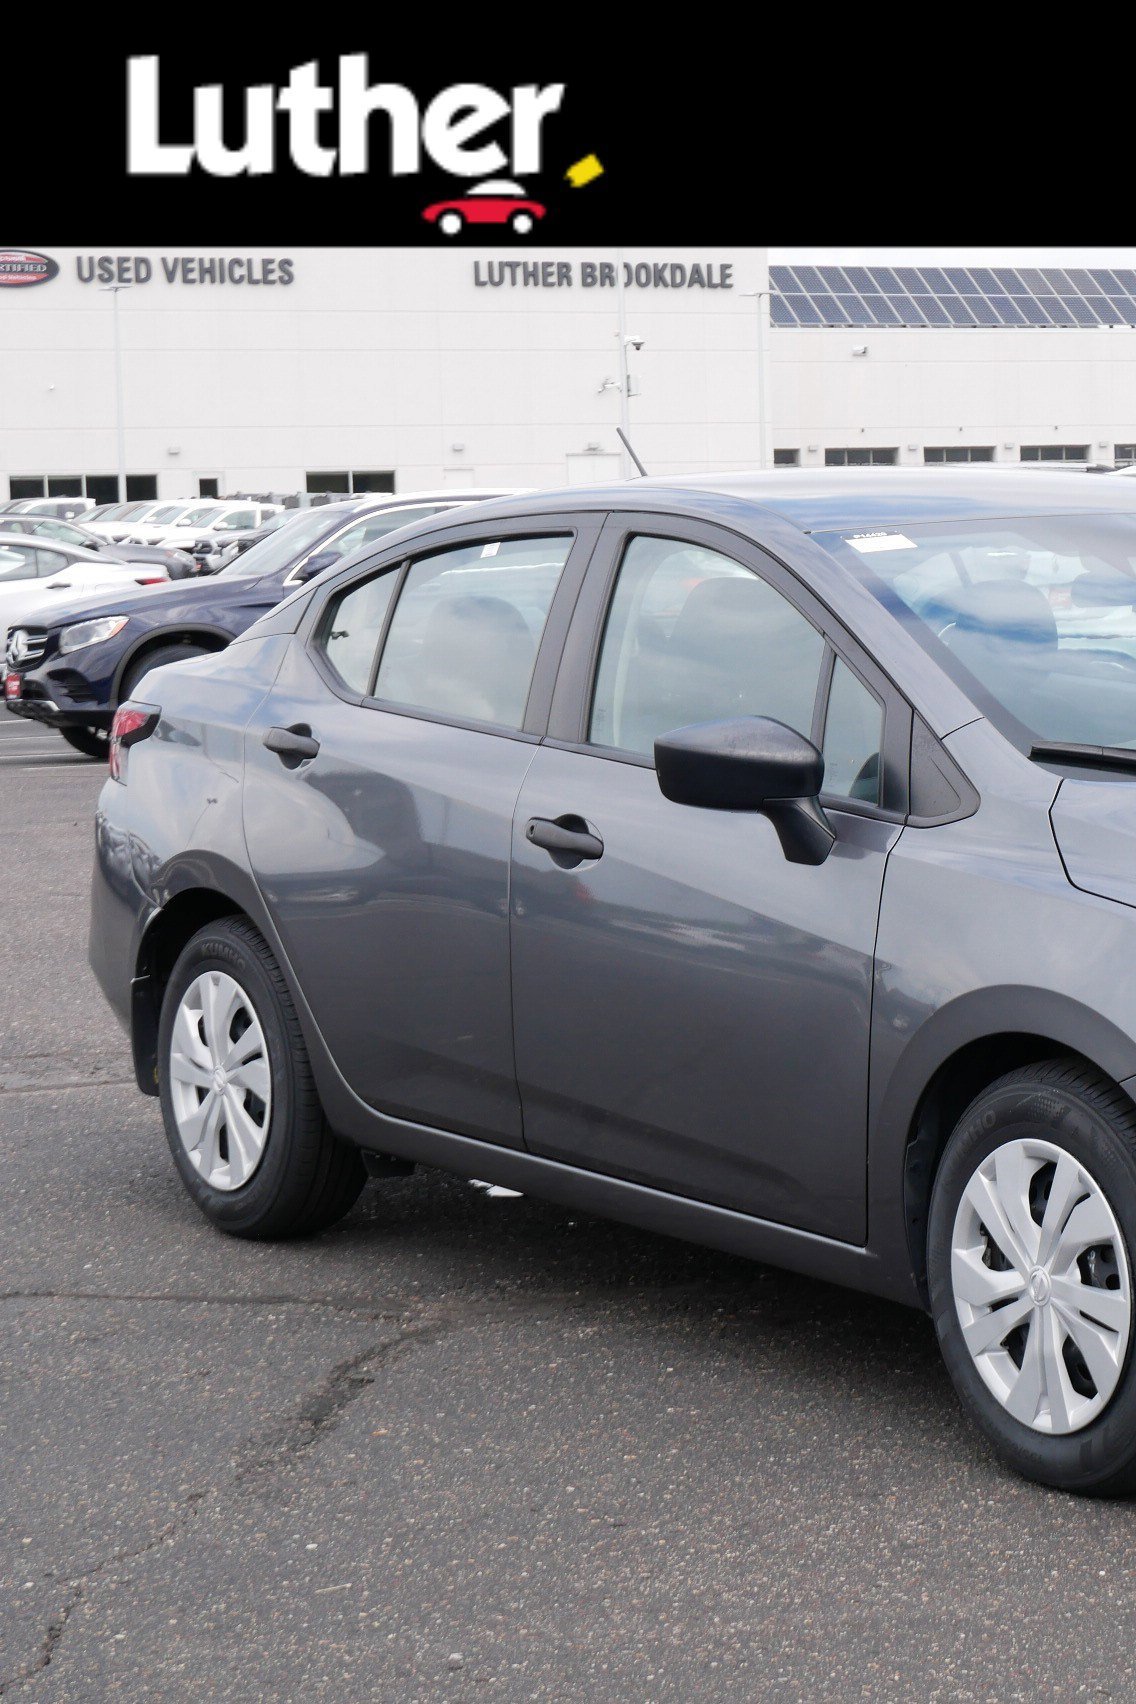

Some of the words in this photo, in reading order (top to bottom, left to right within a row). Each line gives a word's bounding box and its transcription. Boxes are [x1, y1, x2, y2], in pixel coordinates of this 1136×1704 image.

[76, 256, 152, 283] USED
[161, 257, 295, 285] VEHICLES
[474, 261, 573, 287] LUTHER
